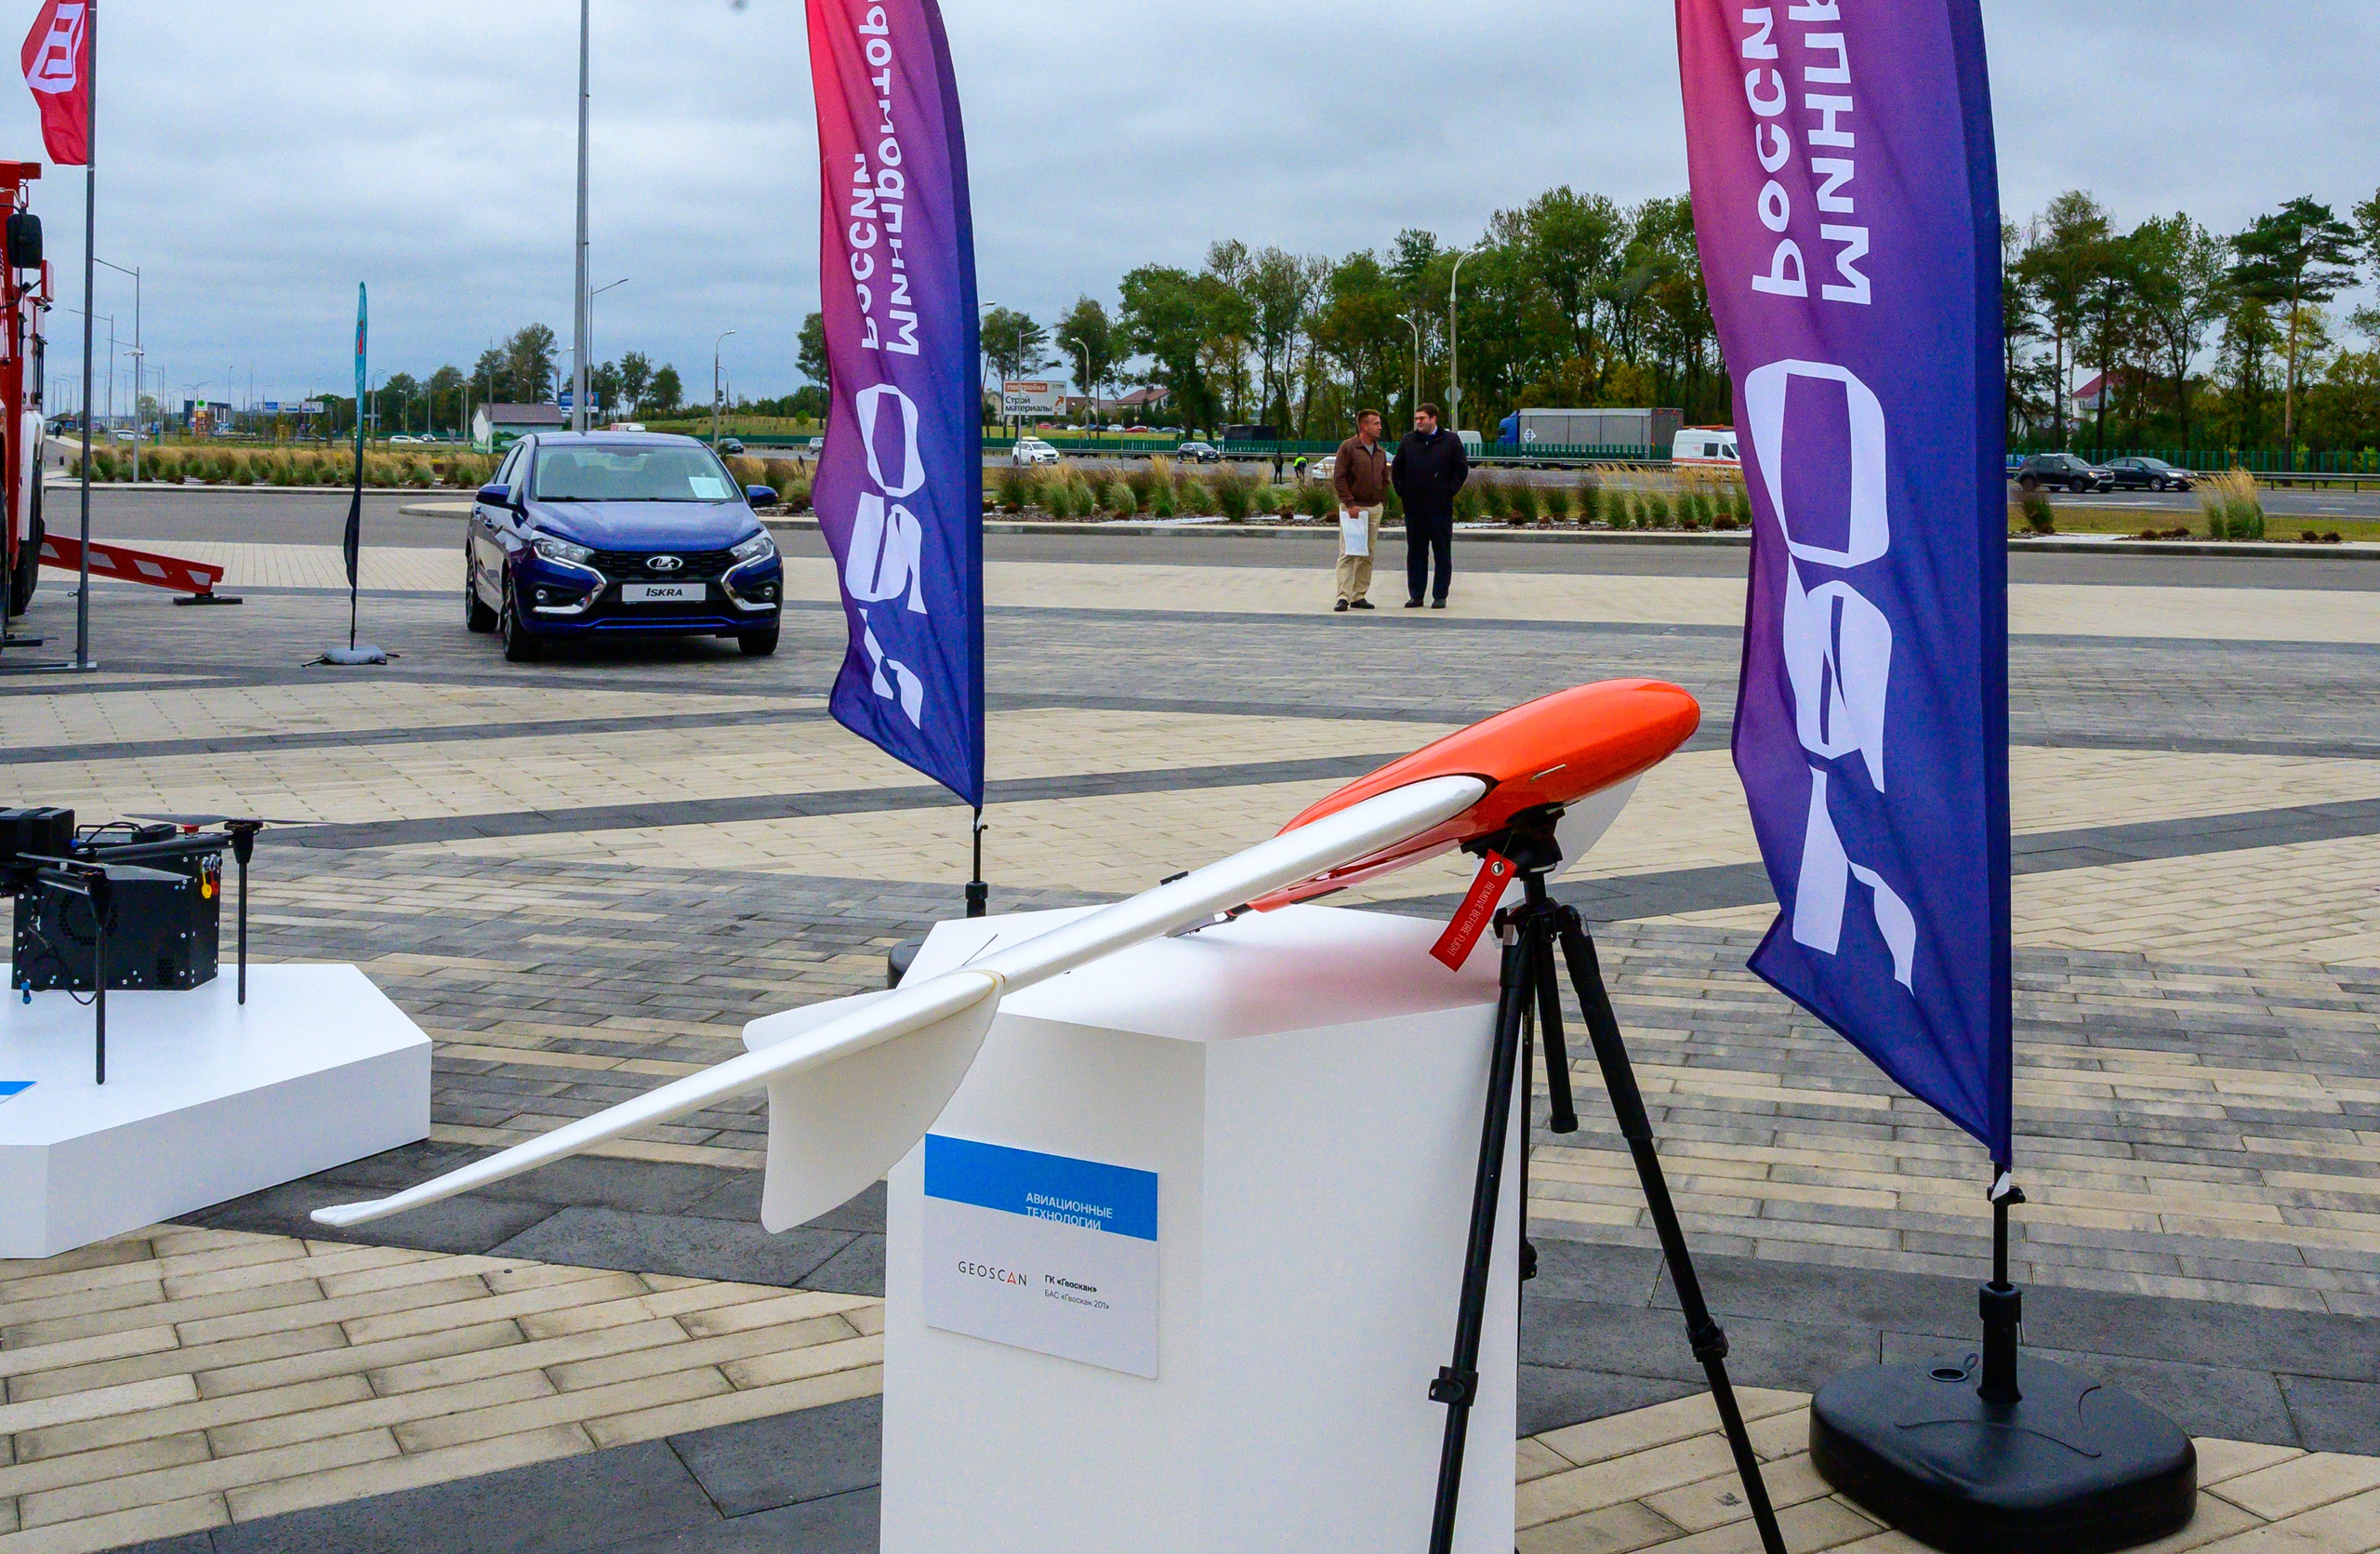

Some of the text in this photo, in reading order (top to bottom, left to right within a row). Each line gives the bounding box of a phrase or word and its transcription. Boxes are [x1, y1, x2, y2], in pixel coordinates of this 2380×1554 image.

[1005, 396, 1031, 405] Строй
[1446, 881, 1496, 957] REMOVE BEFORE FLIGHT
[1025, 1192, 1114, 1219] АВИАЦИОННЫЕ
[1025, 1205, 1102, 1230] ТЕХНОЛОГИИ
[958, 1260, 1027, 1286] GEOSCAN
[1044, 1274, 1098, 1293] ГК «Геоскан»
[1044, 1289, 1110, 1310] БАС «Геоскан 201»
